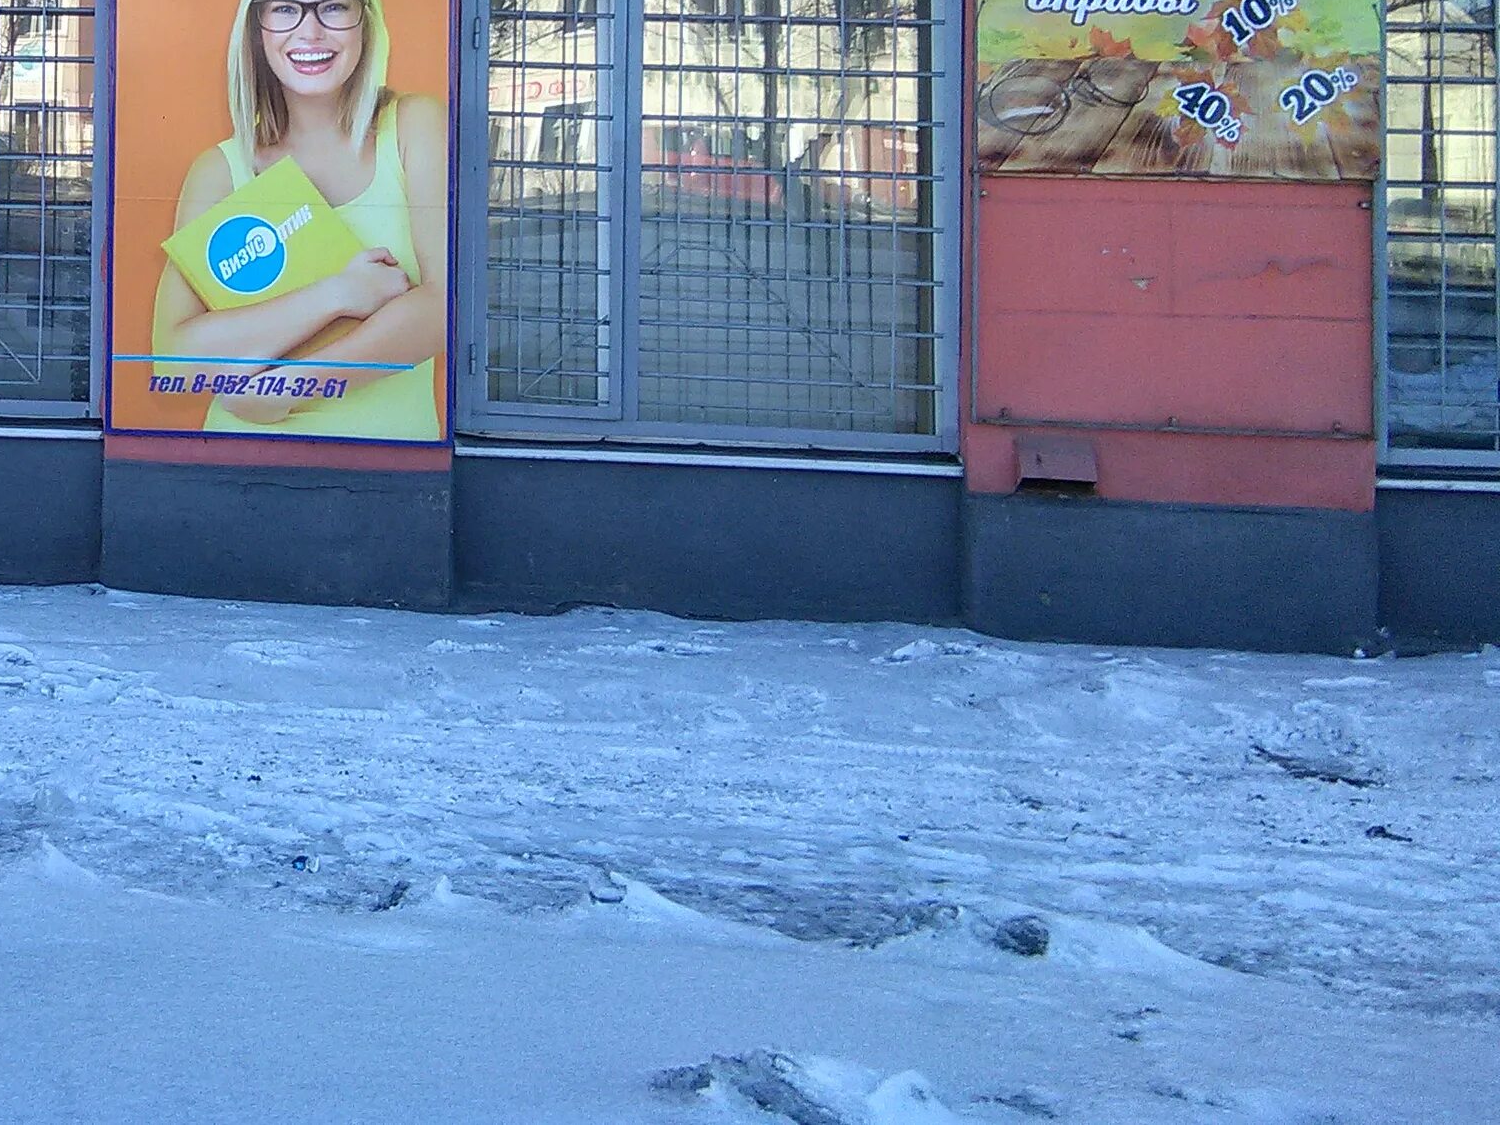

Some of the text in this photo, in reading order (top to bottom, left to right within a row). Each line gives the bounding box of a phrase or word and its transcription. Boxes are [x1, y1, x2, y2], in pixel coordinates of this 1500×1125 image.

[1172, 79, 1242, 143] 40%
[1279, 67, 1358, 124] 20%
[148, 373, 349, 399] тел. 8-952-174-32-61
